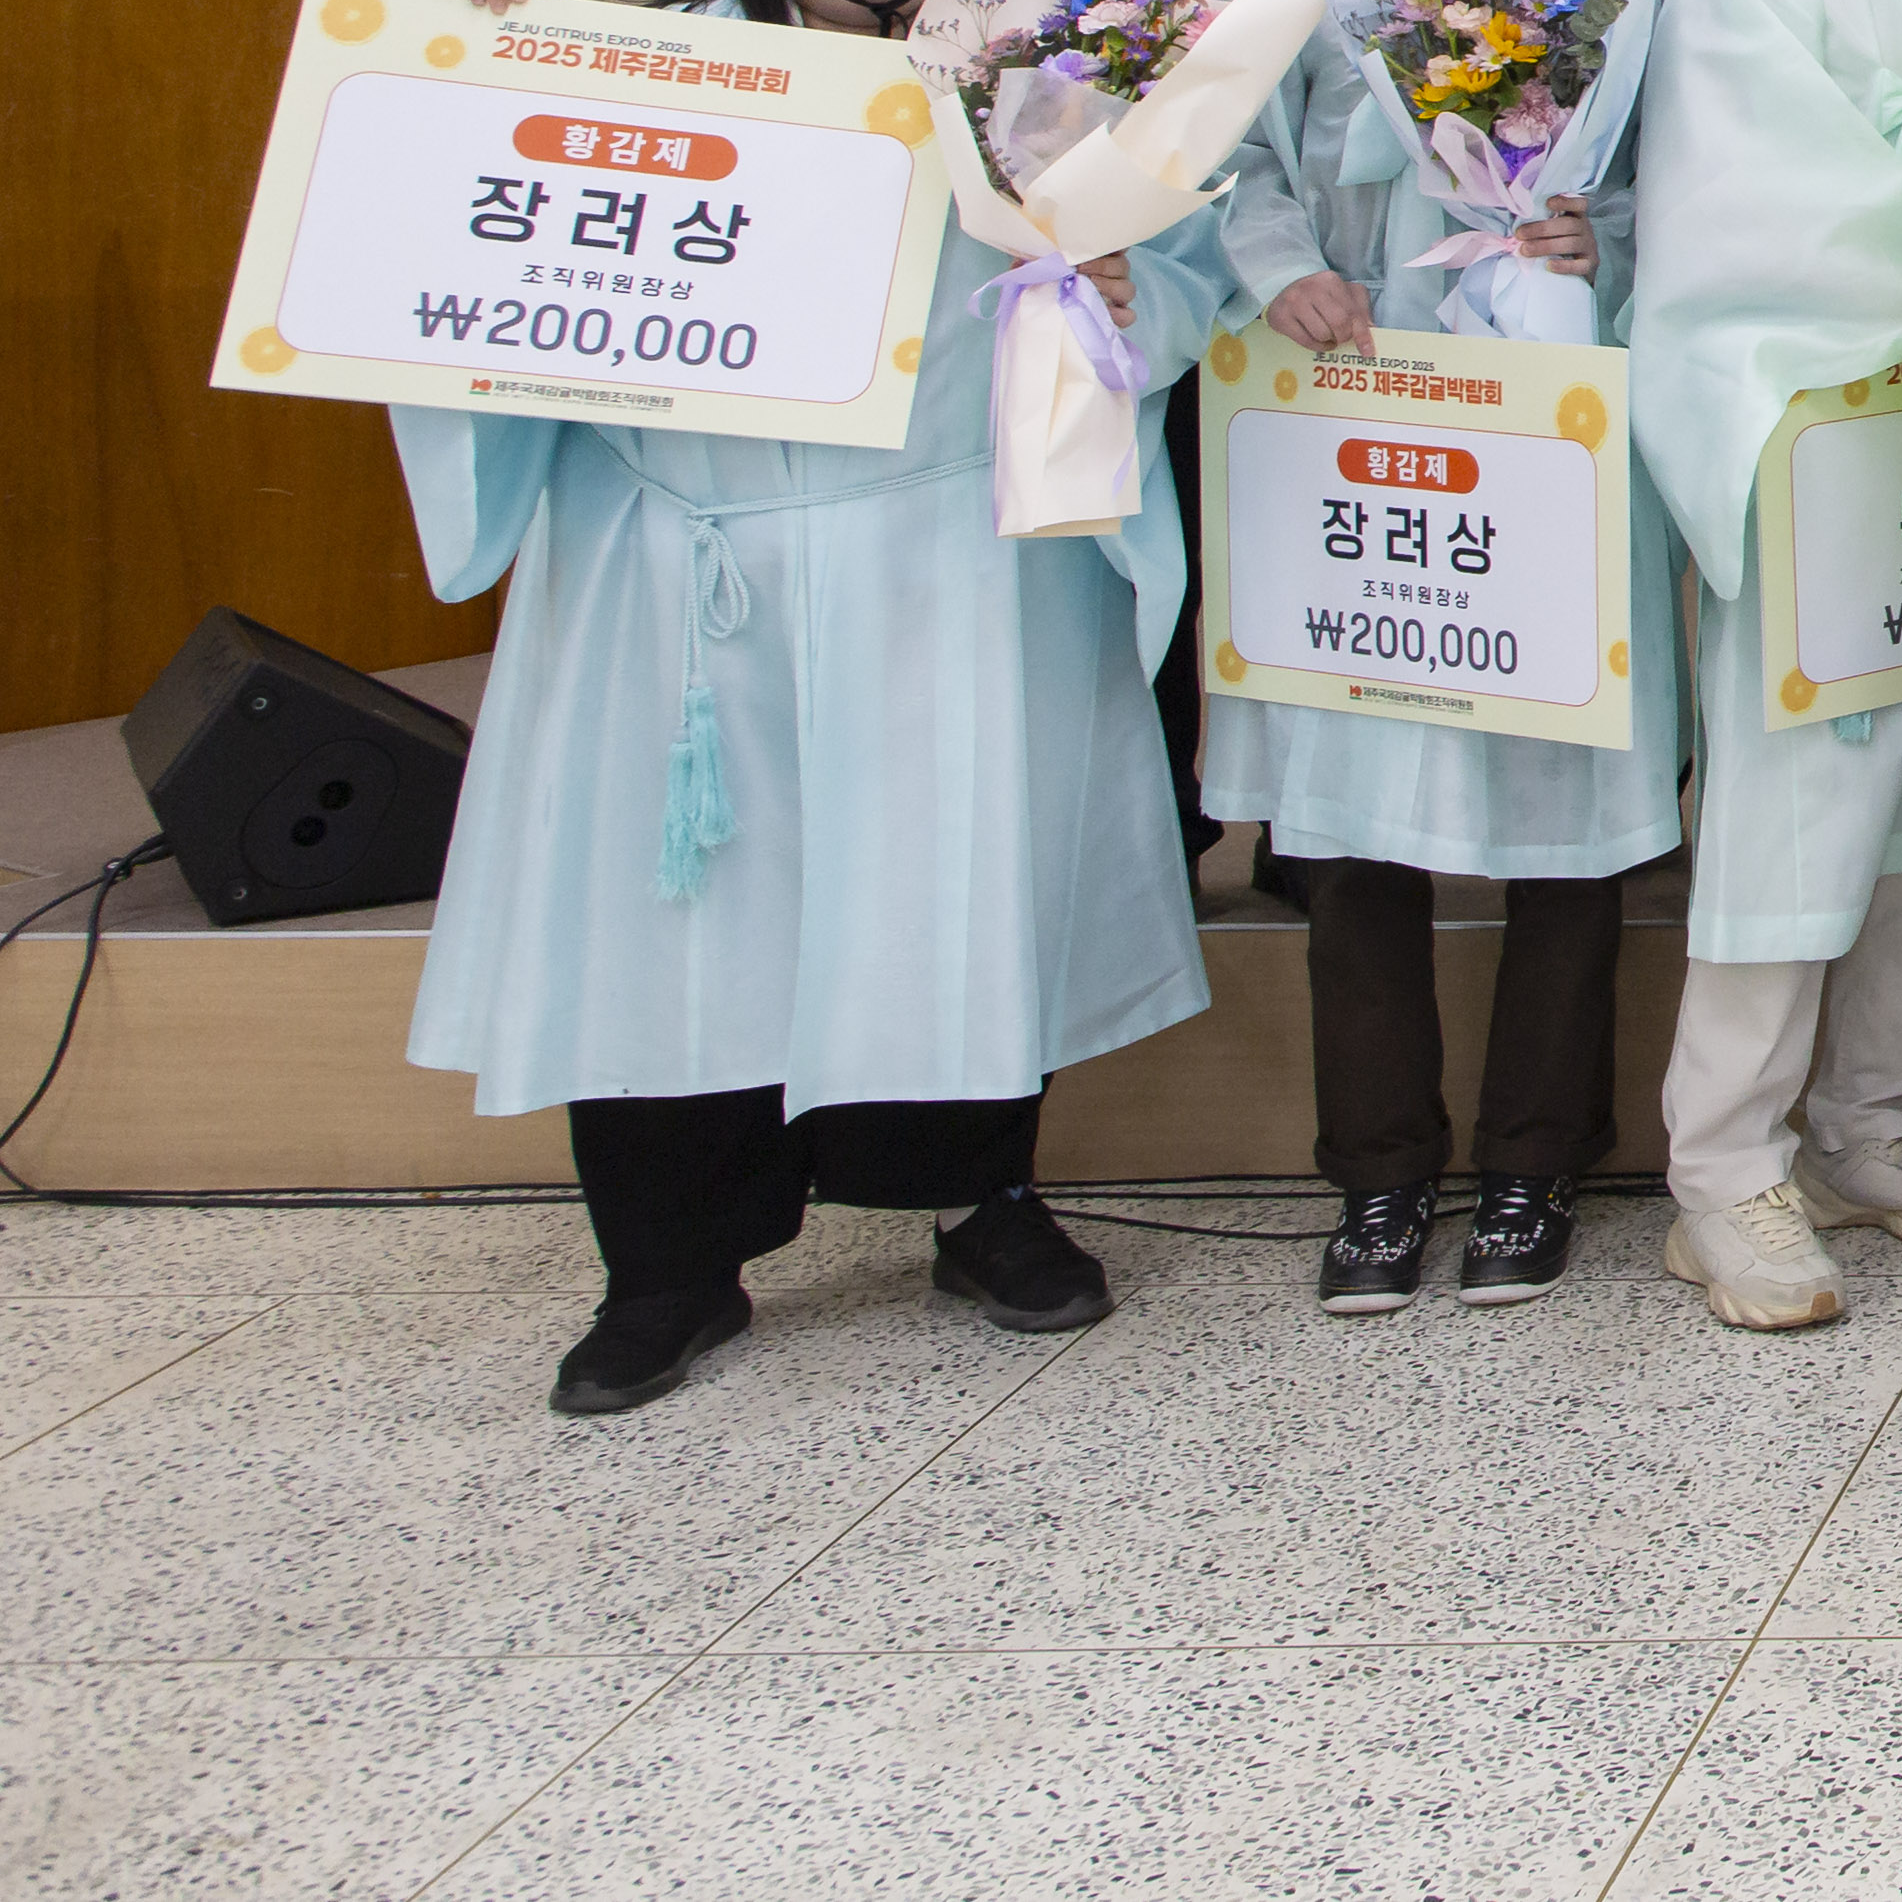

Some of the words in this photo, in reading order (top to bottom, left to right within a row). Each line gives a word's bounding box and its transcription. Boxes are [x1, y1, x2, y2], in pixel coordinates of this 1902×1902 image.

[498, 21, 541, 35] JEJU
[545, 26, 603, 43] CITRUS
[607, 34, 651, 49] EXPO
[656, 40, 692, 55] 2025
[492, 35, 584, 68] 2025
[589, 47, 792, 95] 제주감귤박람회
[562, 123, 692, 171] 황감제
[469, 174, 752, 266] 장려상
[521, 264, 695, 301] 조직위원장상
[1313, 352, 1338, 363] JEJU
[1341, 354, 1377, 367] CITRUS
[1380, 358, 1409, 370] EXPO
[1411, 361, 1435, 372] 2025
[1313, 365, 1368, 392] 2025
[1372, 370, 1502, 406] 제주감귤박람회
[1367, 446, 1448, 486] 황감제
[1321, 498, 1497, 575] 장려상
[1362, 579, 1470, 610] 조직위원장상
